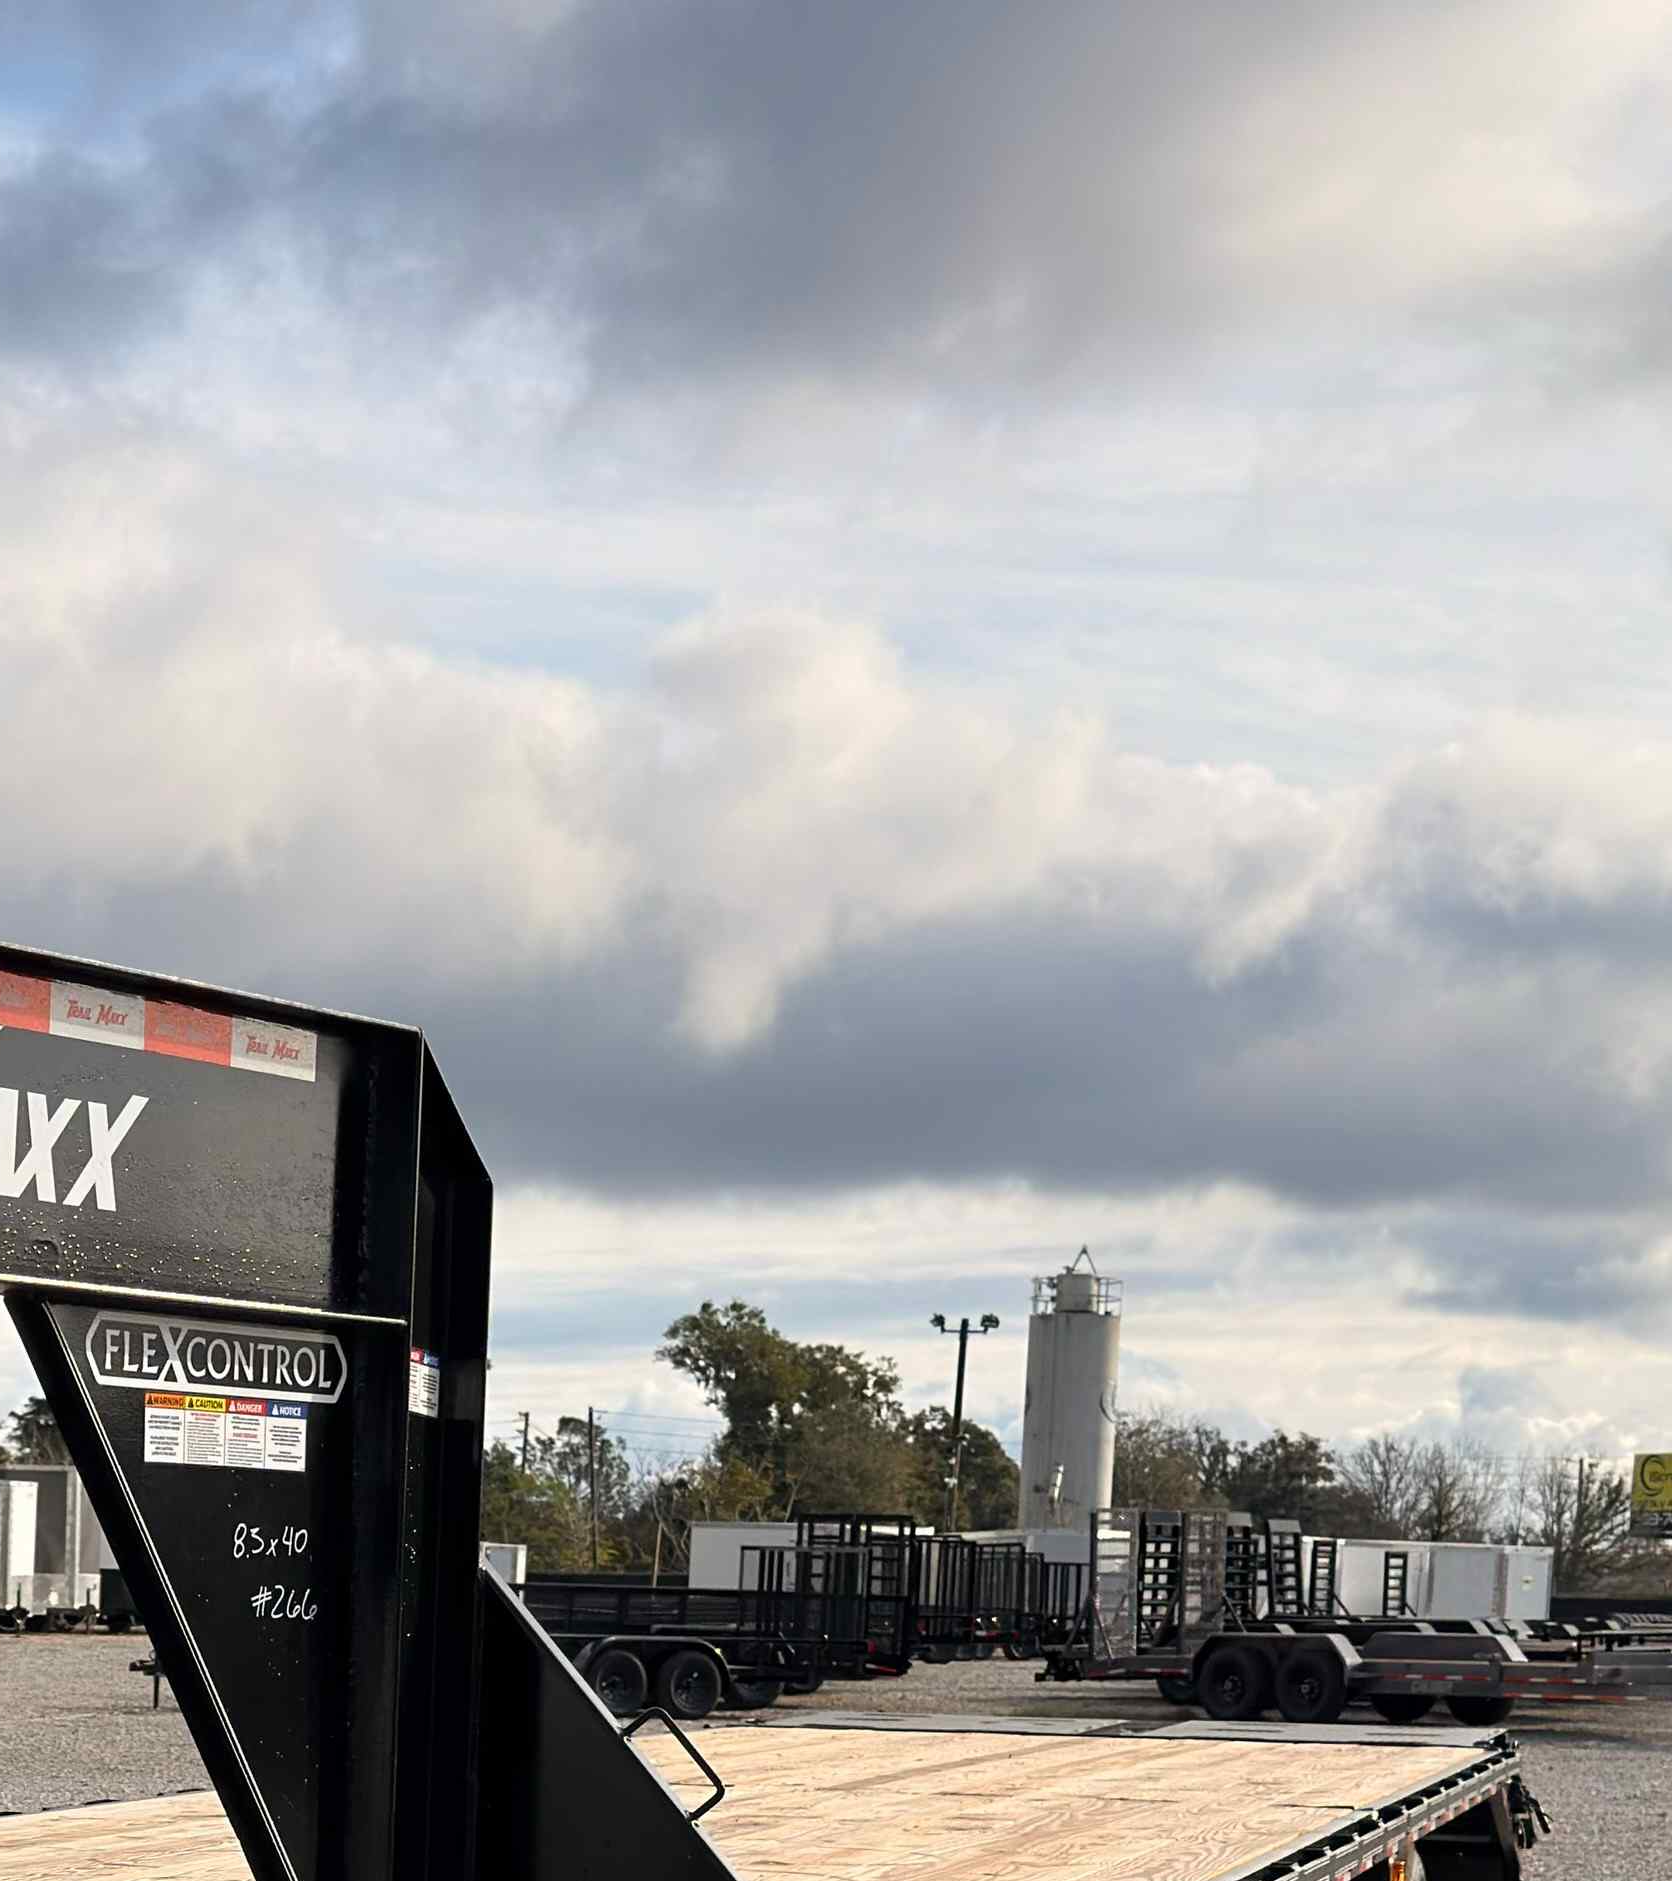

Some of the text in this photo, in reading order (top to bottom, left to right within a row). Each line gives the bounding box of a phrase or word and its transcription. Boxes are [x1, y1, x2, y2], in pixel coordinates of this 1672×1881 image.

[195, 1397, 224, 1409] CAUTION
[279, 1406, 301, 1417] NOTICE
[250, 1584, 318, 1620] #266
